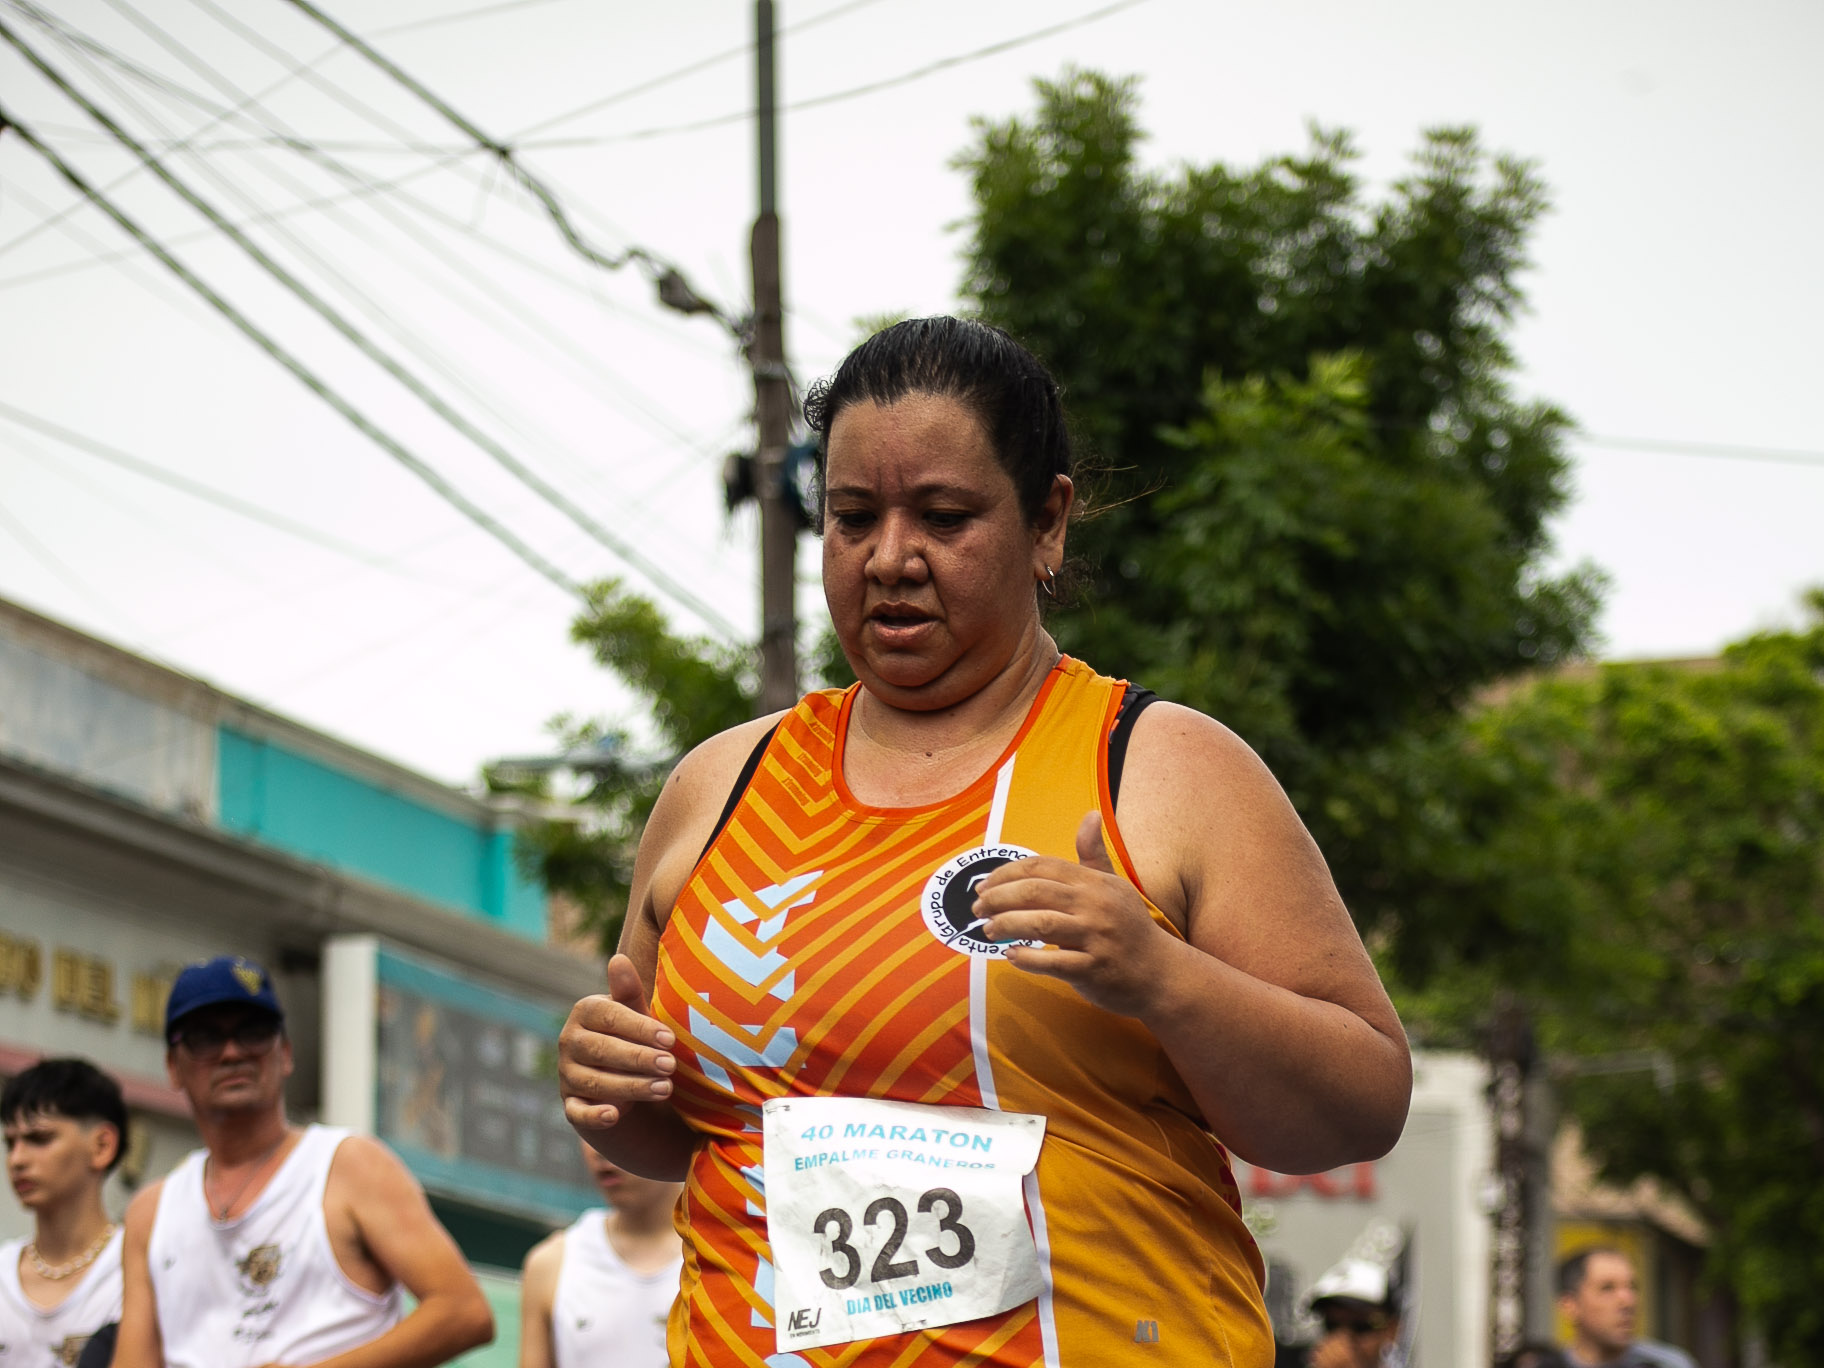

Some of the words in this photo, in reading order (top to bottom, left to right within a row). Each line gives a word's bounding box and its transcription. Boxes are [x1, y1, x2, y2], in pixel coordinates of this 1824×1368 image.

[936, 870, 954, 886] de
[931, 891, 955, 940] Grupo
[801, 1125, 834, 1141] 40
[843, 1123, 993, 1152] MARATON
[795, 1149, 880, 1171] EMPALME
[886, 1149, 996, 1169] GRANEROS
[813, 1187, 976, 1290] 323
[847, 1298, 872, 1316] DIA
[874, 1292, 897, 1310] DEL
[899, 1281, 955, 1306] VECINO
[788, 1307, 822, 1331] NEJ
